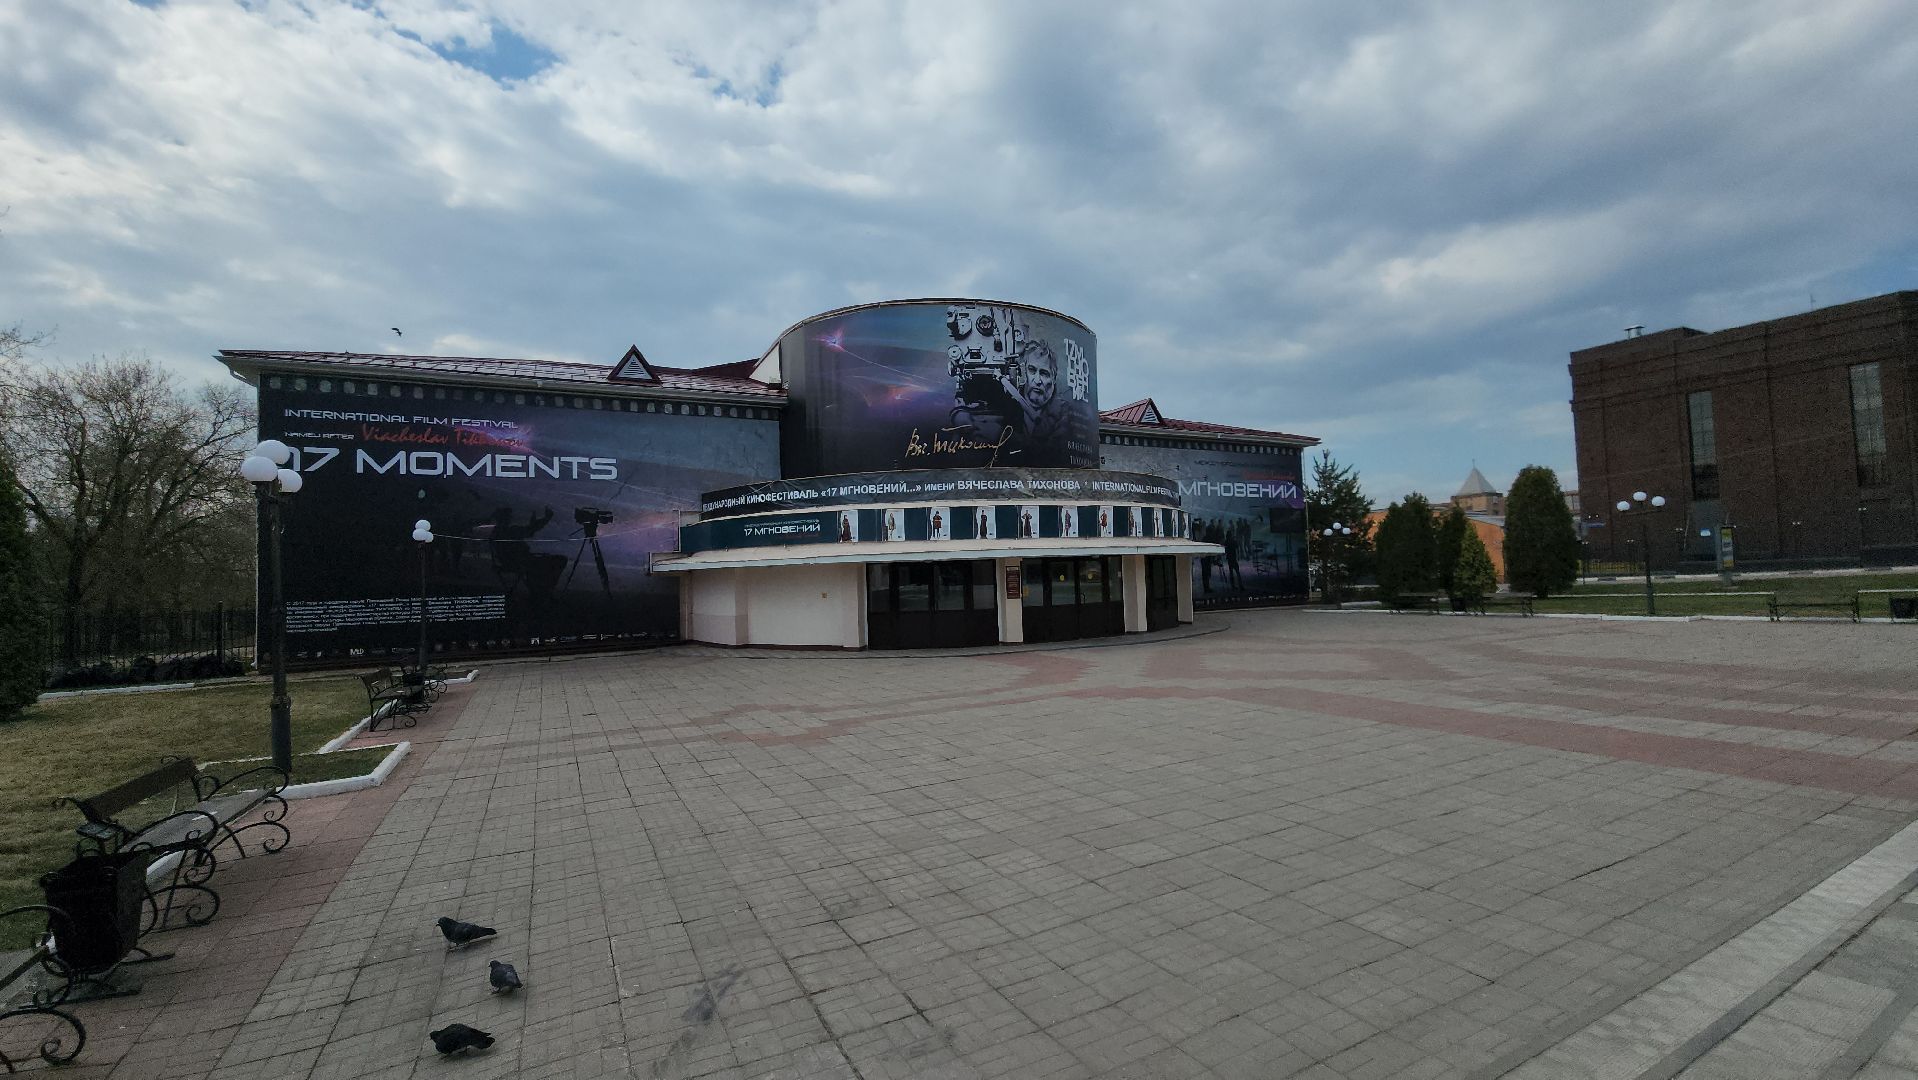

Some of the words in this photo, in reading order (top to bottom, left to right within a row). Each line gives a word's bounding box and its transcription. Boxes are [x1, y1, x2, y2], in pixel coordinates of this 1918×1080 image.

[284, 408, 410, 423] INTERNATIONAL
[413, 416, 448, 425] FILM
[451, 418, 518, 429] FESTIVAL
[356, 447, 618, 481] MOMENTS
[746, 489, 819, 505] КИНОФЕСТИВАЛЬ
[957, 480, 1025, 491] ВЯЧЕСЛАВА
[1026, 480, 1081, 491] ТИХОНОВА
[1092, 481, 1146, 494] INTERNATIONAL
[1178, 481, 1297, 499] МГНОВЕНИЙ
[744, 527, 753, 537] 17
[754, 522, 821, 536] МГНОВЕНИЙ
